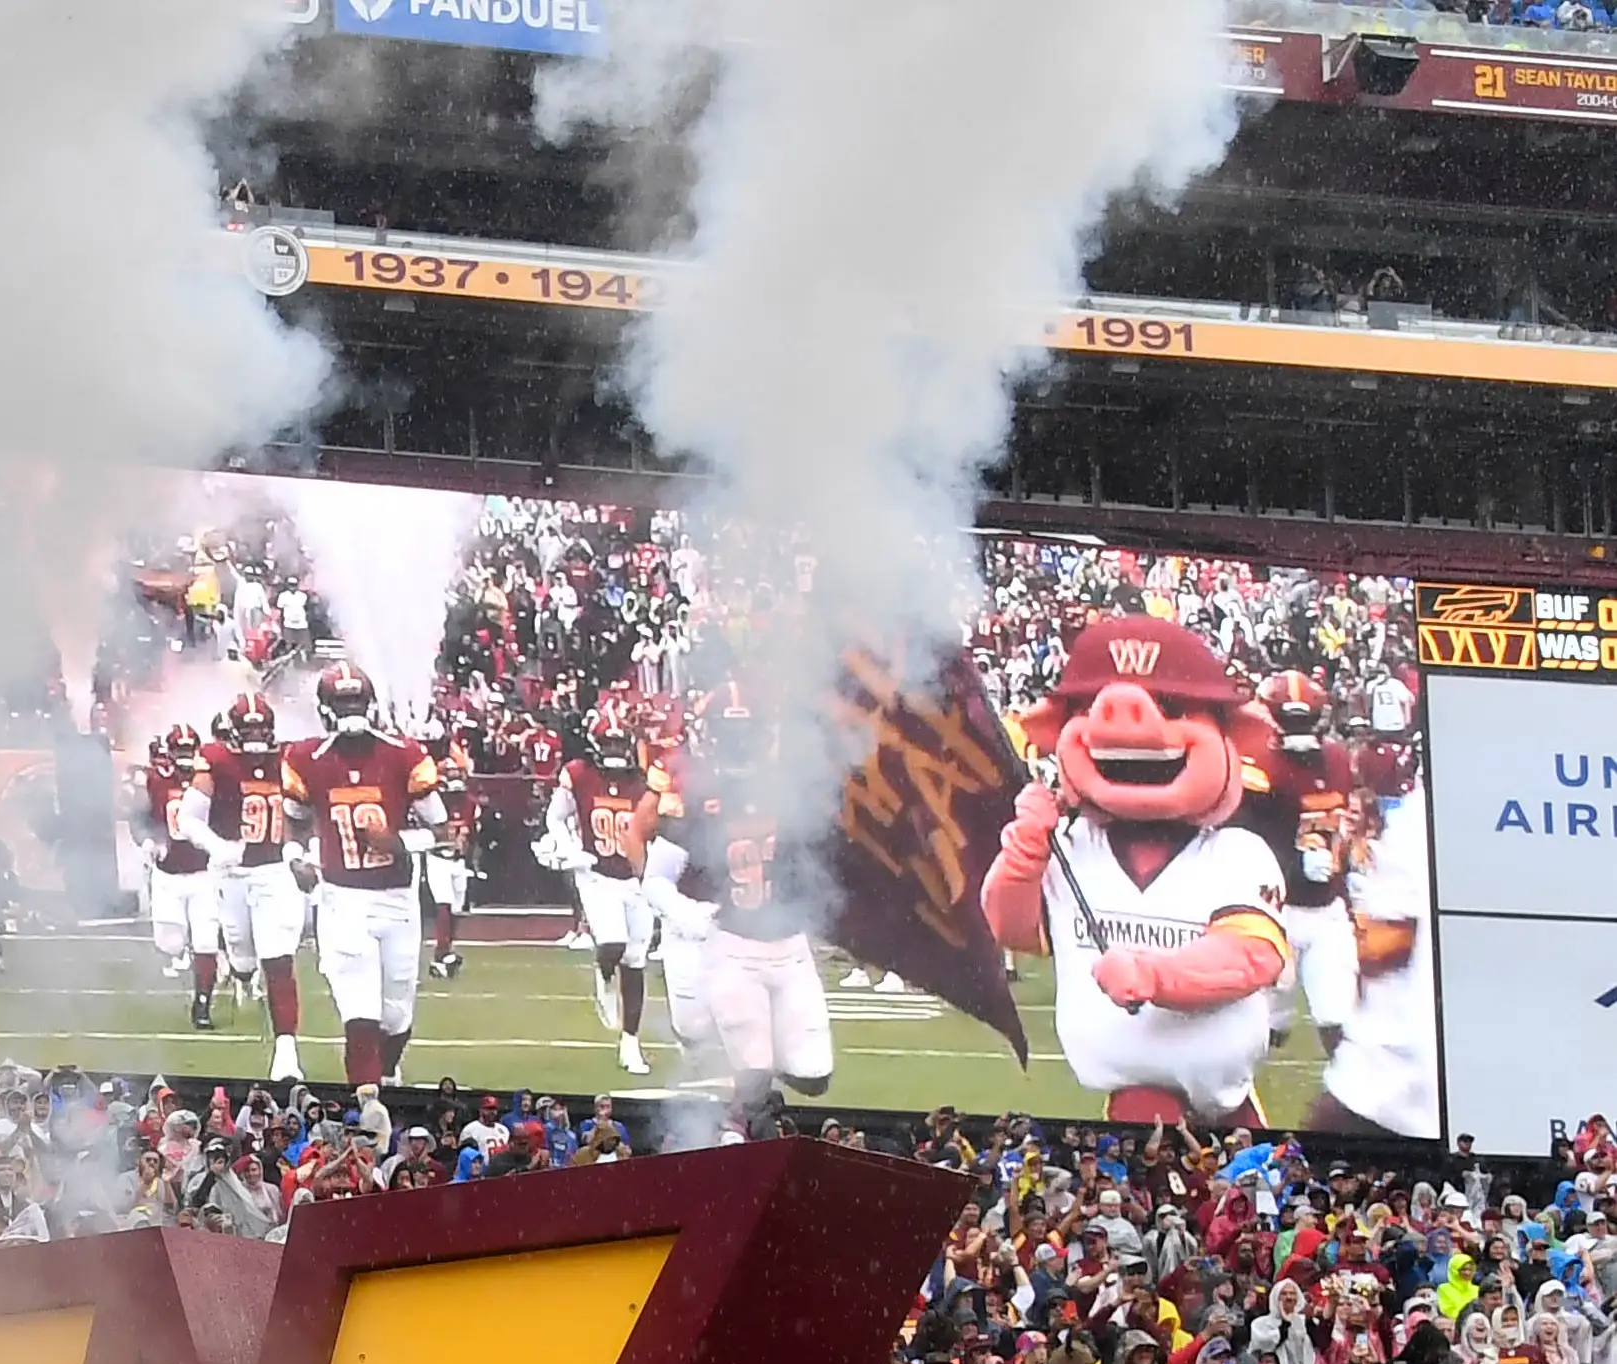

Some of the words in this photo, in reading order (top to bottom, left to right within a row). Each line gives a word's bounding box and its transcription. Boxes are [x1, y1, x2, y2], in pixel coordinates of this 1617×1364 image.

[1474, 65, 1508, 98] 21
[1513, 67, 1562, 88] SEAN
[343, 250, 480, 290] 1937
[1076, 317, 1194, 352] 1991
[1535, 593, 1591, 621] BUF
[1536, 632, 1601, 661] WAS
[240, 794, 283, 844] 91
[1494, 800, 1617, 838] AIR
[329, 804, 395, 871] 12
